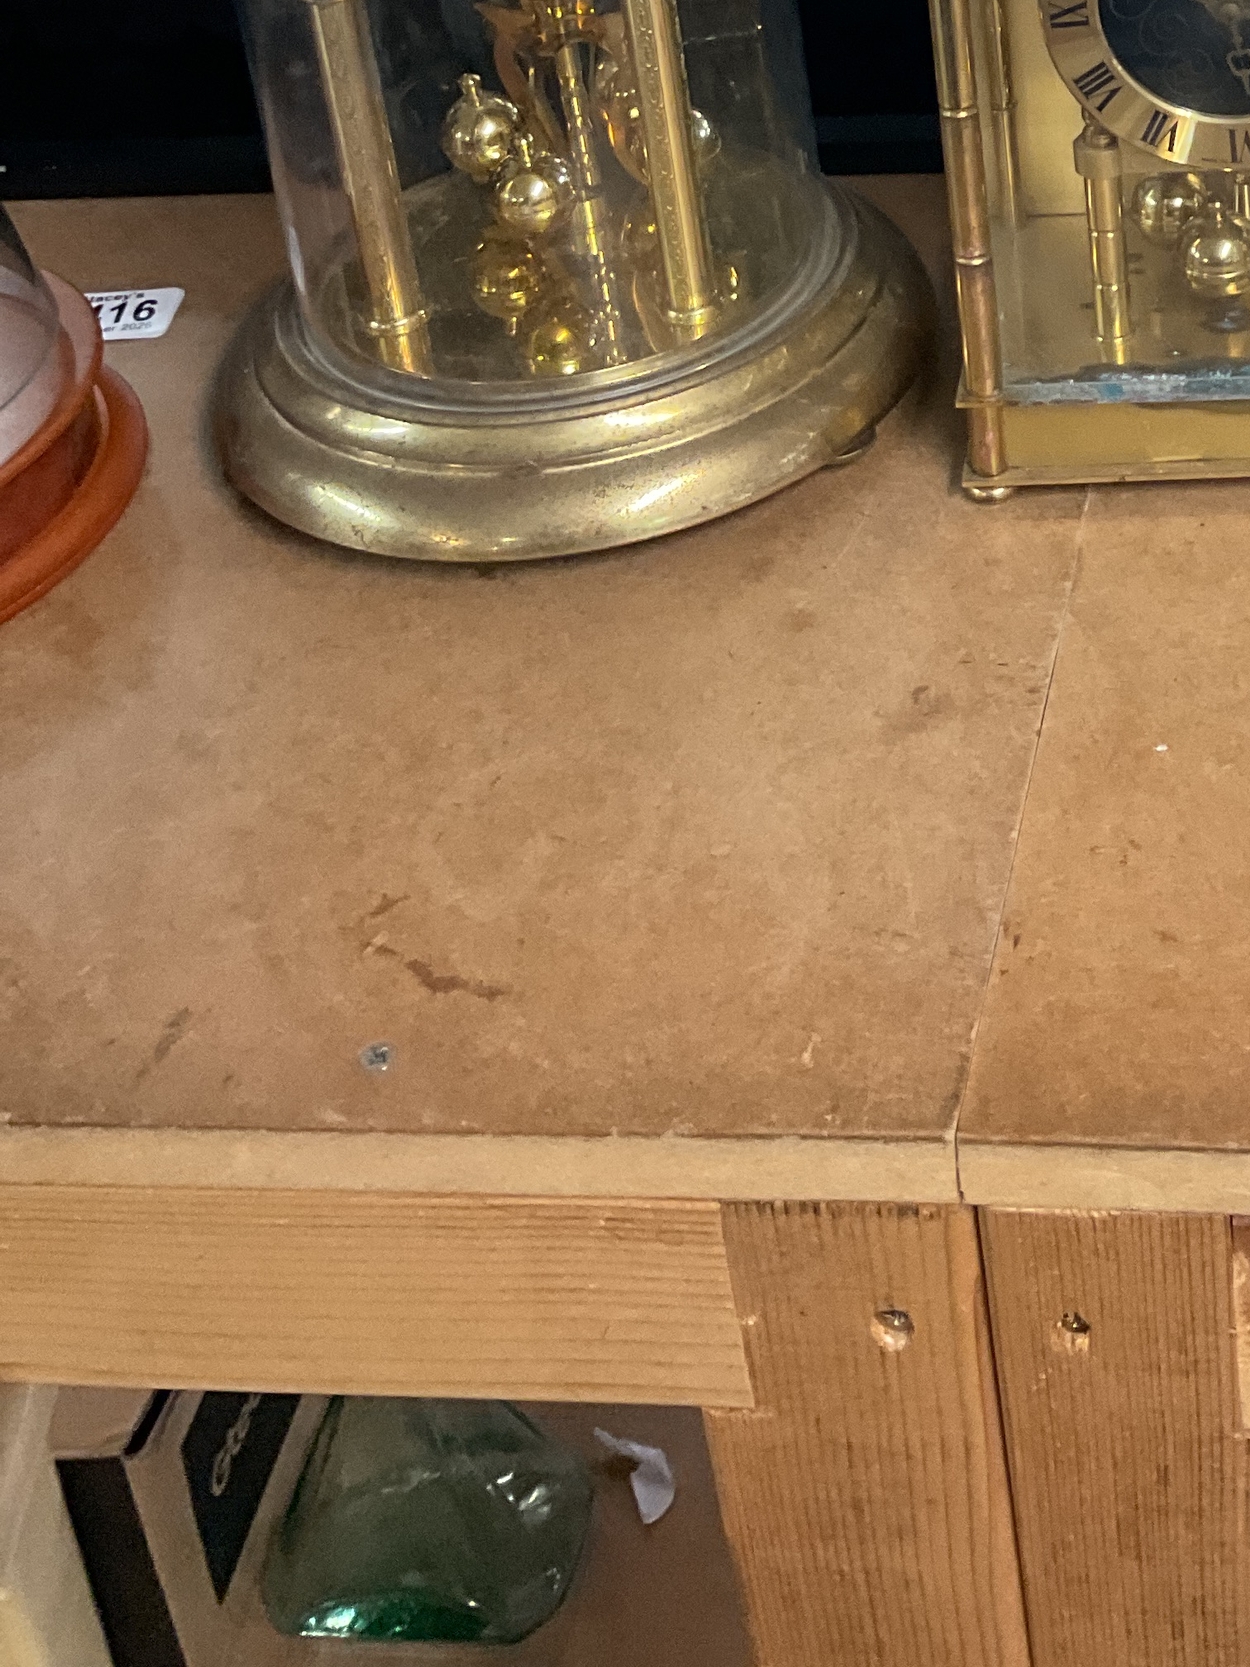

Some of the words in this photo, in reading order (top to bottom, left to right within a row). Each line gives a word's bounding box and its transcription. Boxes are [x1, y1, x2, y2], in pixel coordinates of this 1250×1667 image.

[1049, 0, 1090, 28] IX
[1073, 62, 1123, 112] VIII
[1142, 110, 1179, 153] VII
[89, 292, 145, 303] tacey's
[93, 300, 158, 323] 16
